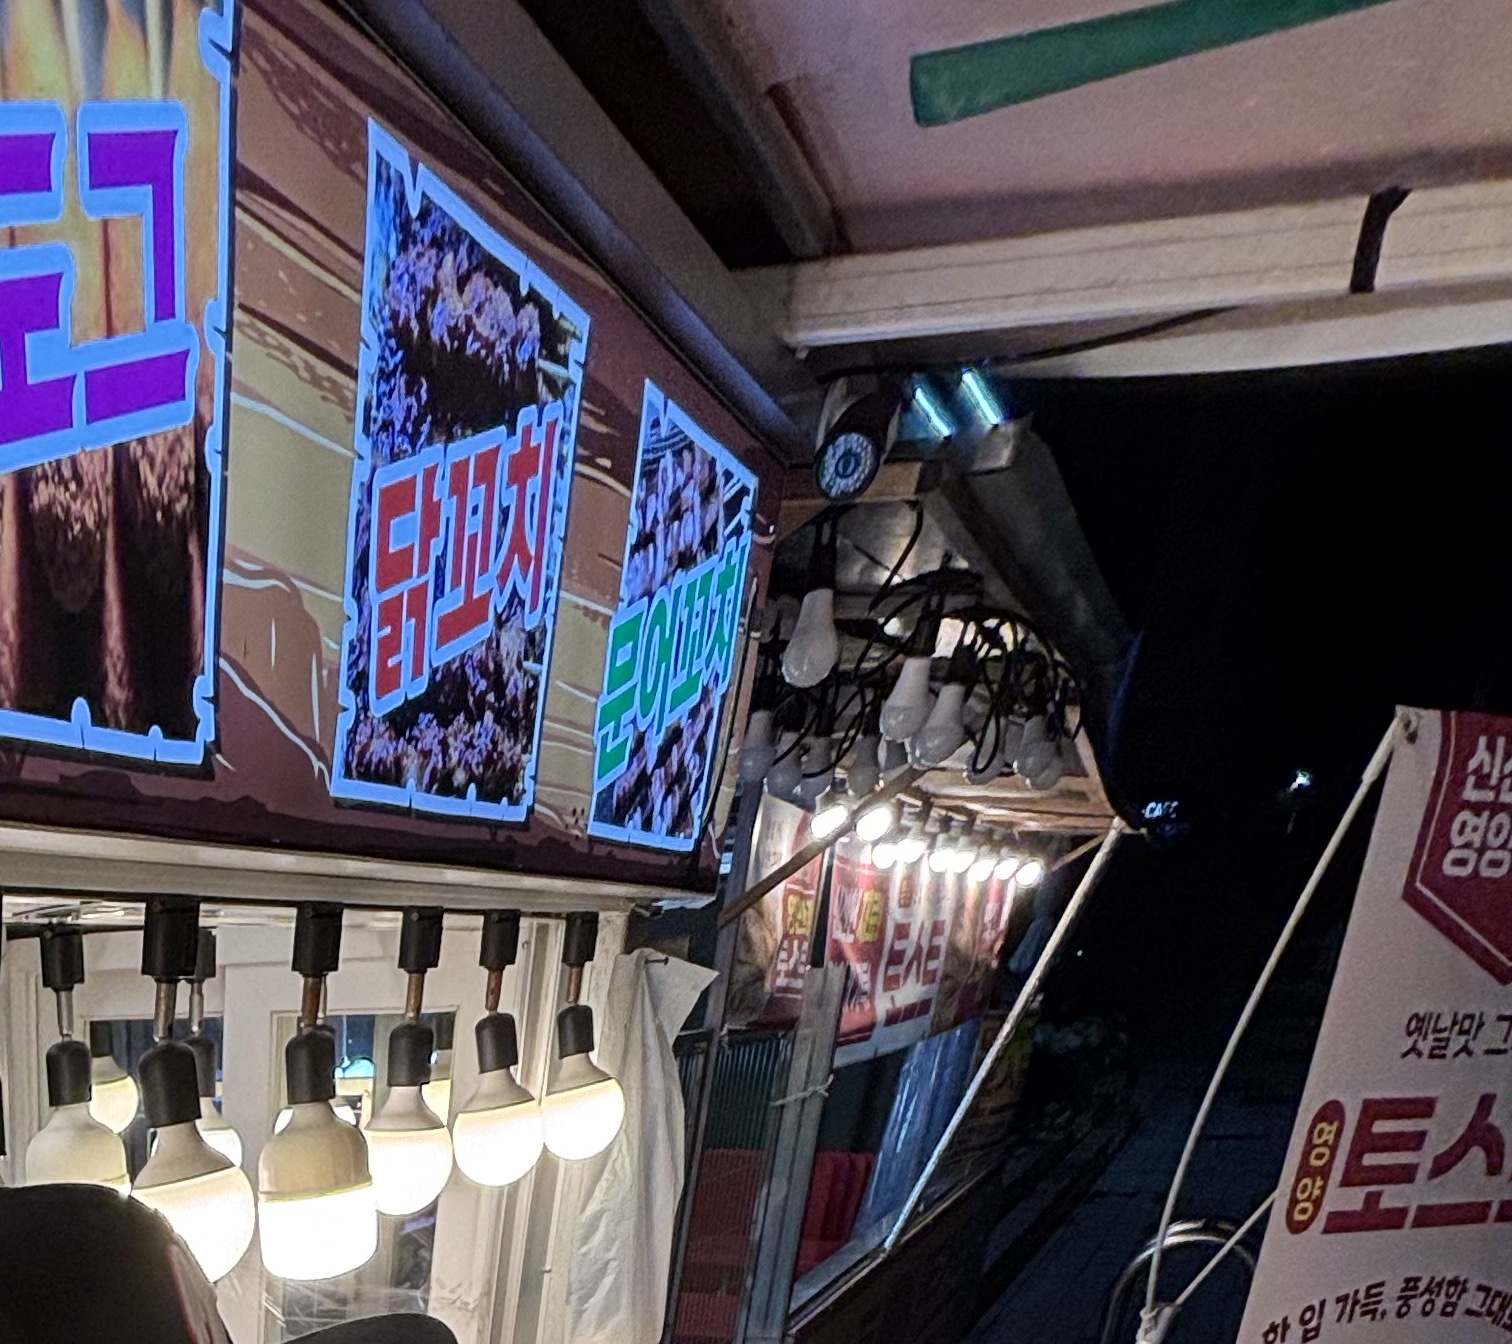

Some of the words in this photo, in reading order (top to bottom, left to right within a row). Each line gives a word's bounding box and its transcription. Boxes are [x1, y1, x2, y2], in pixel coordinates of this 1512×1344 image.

[372, 414, 561, 704] 닭꼬치
[596, 536, 752, 784] 문어꼬치
[1400, 1010, 1486, 1061] 옛날맛
[1293, 1120, 1339, 1222] 영양
[1320, 1091, 1512, 1236] 토스
[1297, 1297, 1328, 1344] 입
[1394, 1273, 1471, 1320] 풍성함
